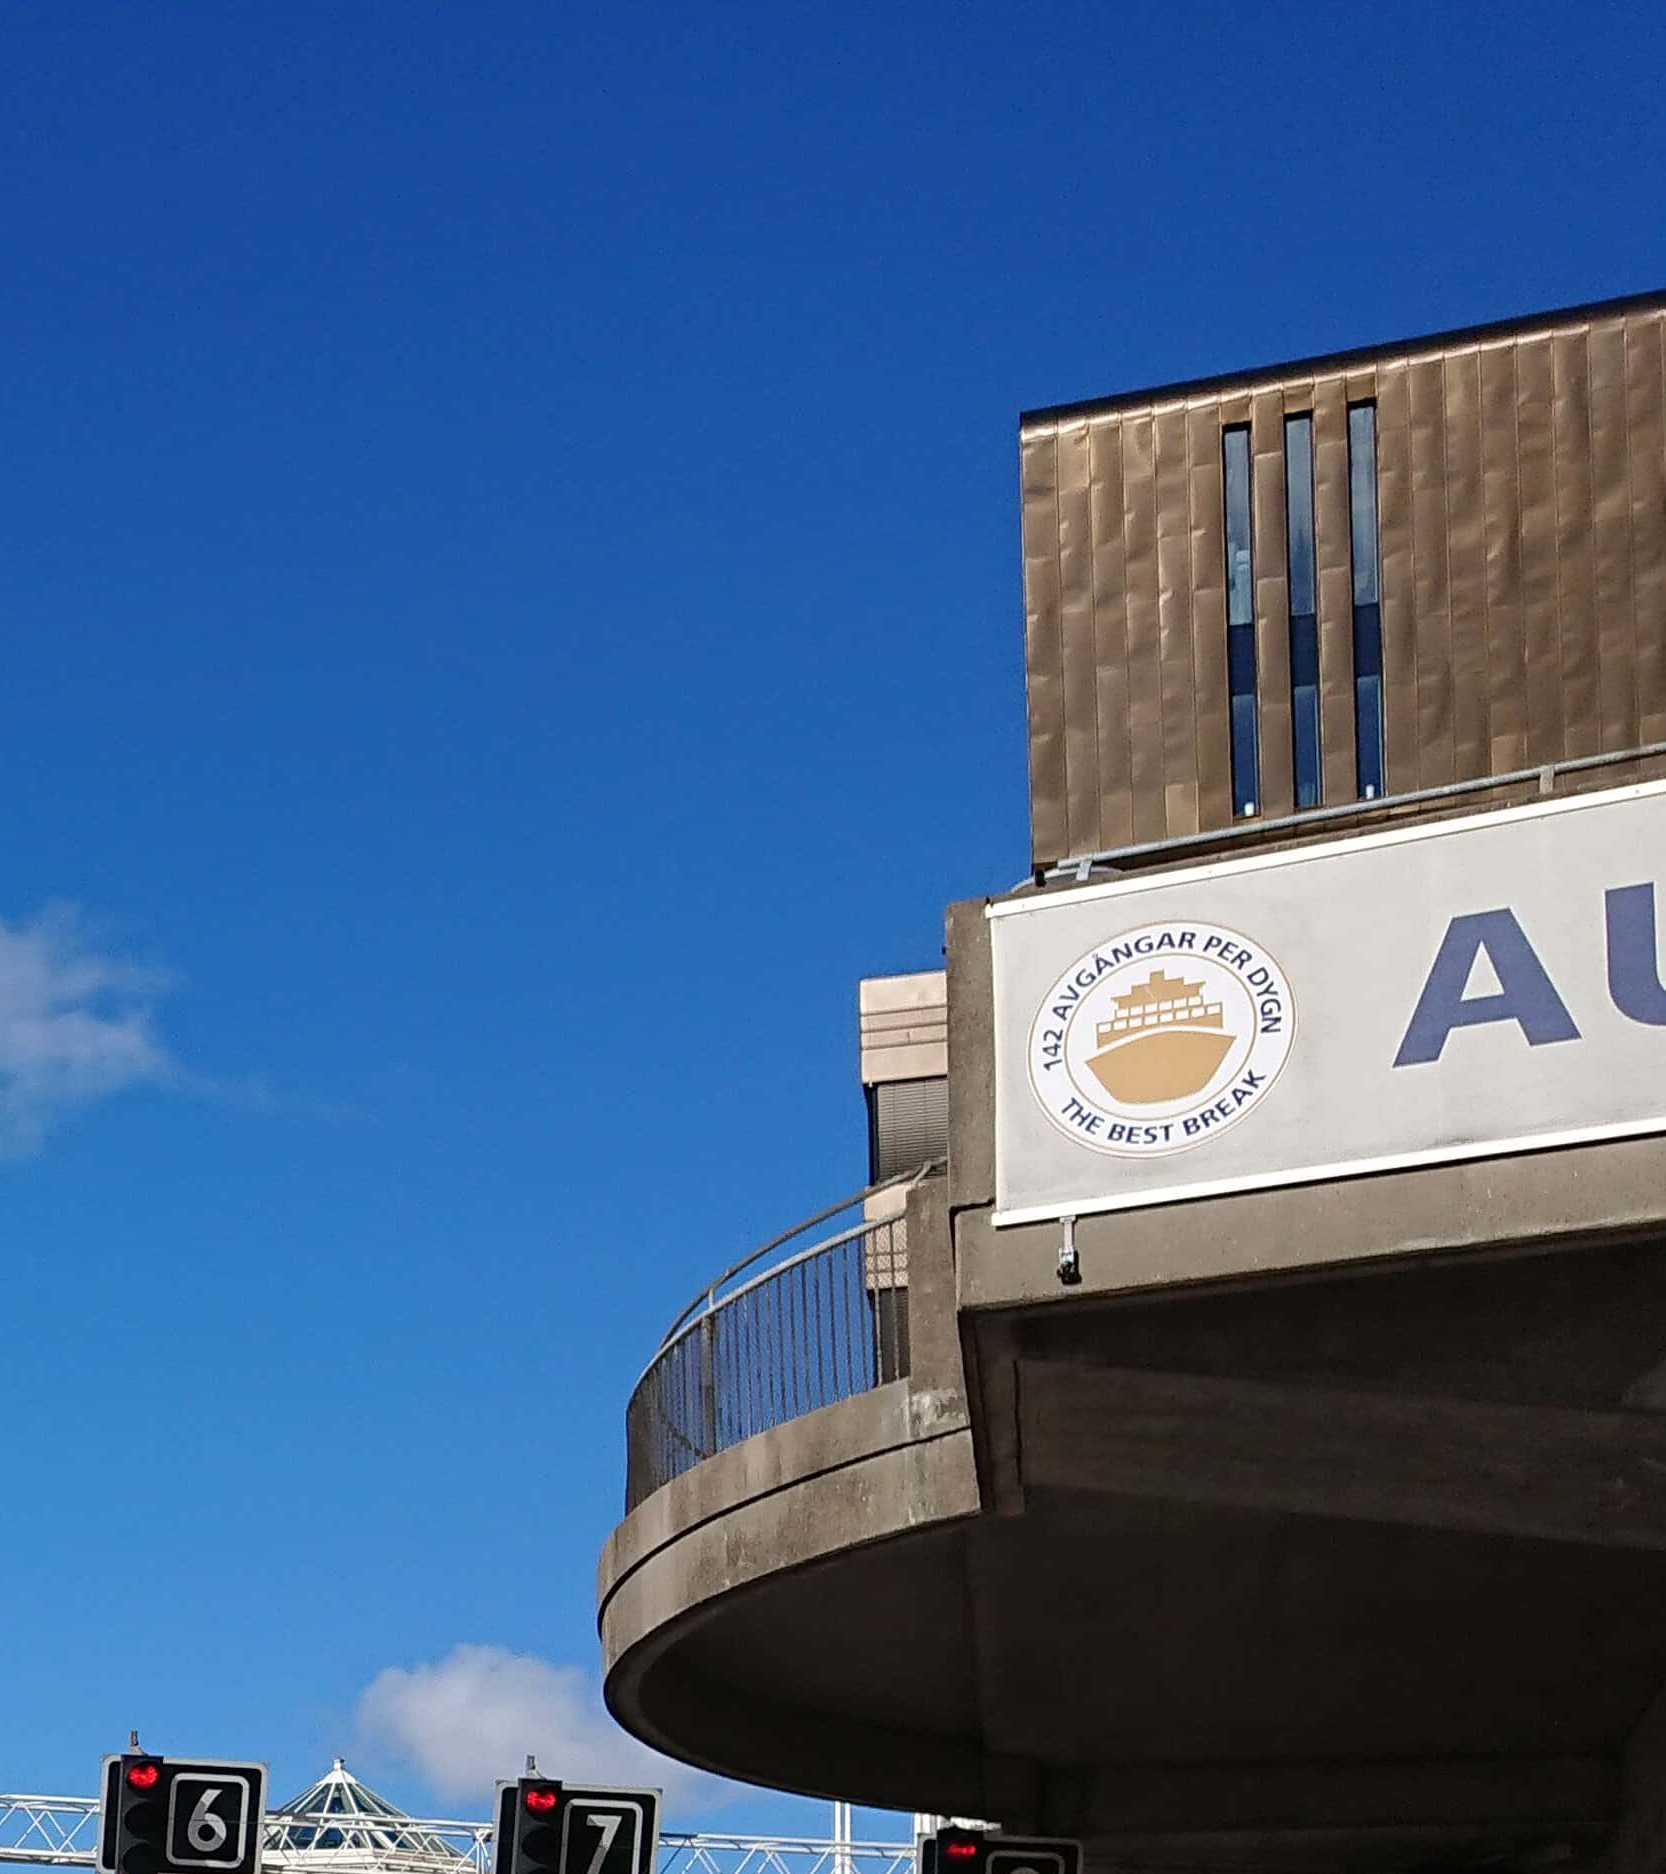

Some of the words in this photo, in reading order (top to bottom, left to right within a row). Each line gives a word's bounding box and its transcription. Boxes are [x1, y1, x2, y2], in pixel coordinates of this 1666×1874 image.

[1051, 931, 1197, 1022] AVGÅNGAR
[1202, 934, 1253, 971] PER
[1246, 966, 1282, 1035] DYGN
[1042, 1027, 1064, 1072] 142
[1060, 1096, 1106, 1136] THE
[1107, 1122, 1174, 1145] BEST
[1181, 1068, 1267, 1138] BREAK
[188, 1789, 226, 1851] 6
